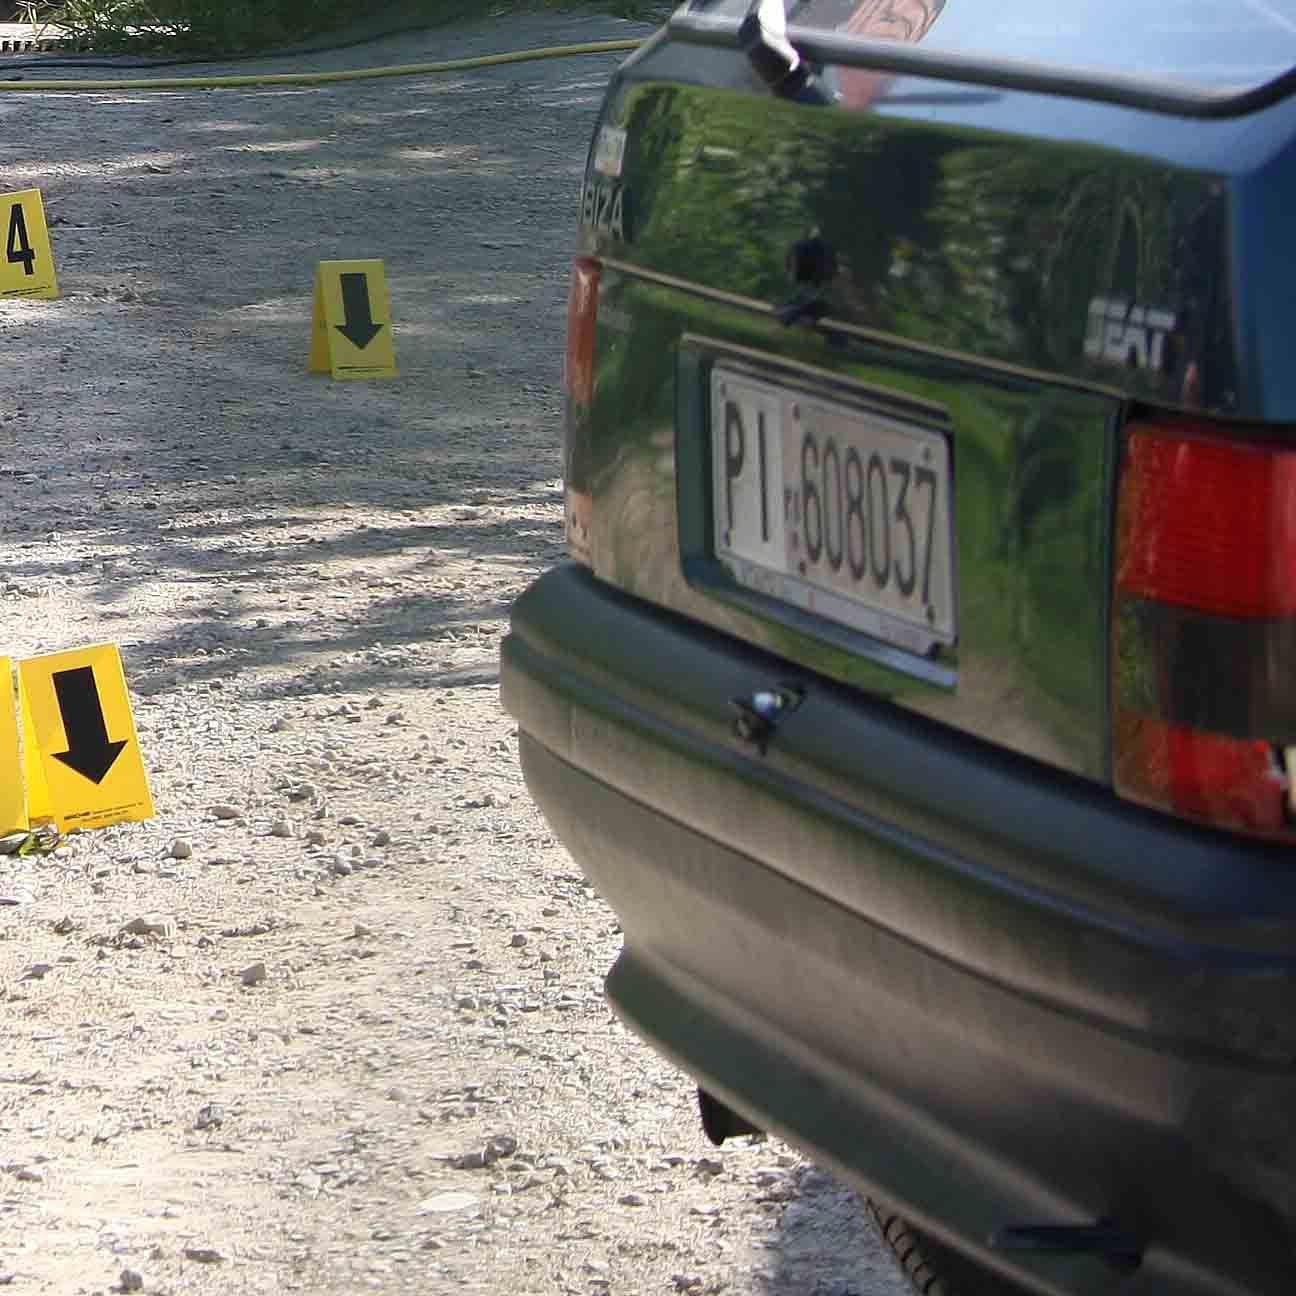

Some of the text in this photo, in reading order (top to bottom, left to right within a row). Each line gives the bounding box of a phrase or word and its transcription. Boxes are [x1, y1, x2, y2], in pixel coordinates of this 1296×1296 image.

[6, 203, 35, 275] 4
[1083, 298, 1176, 370] SEAT
[803, 431, 937, 605] 608037
